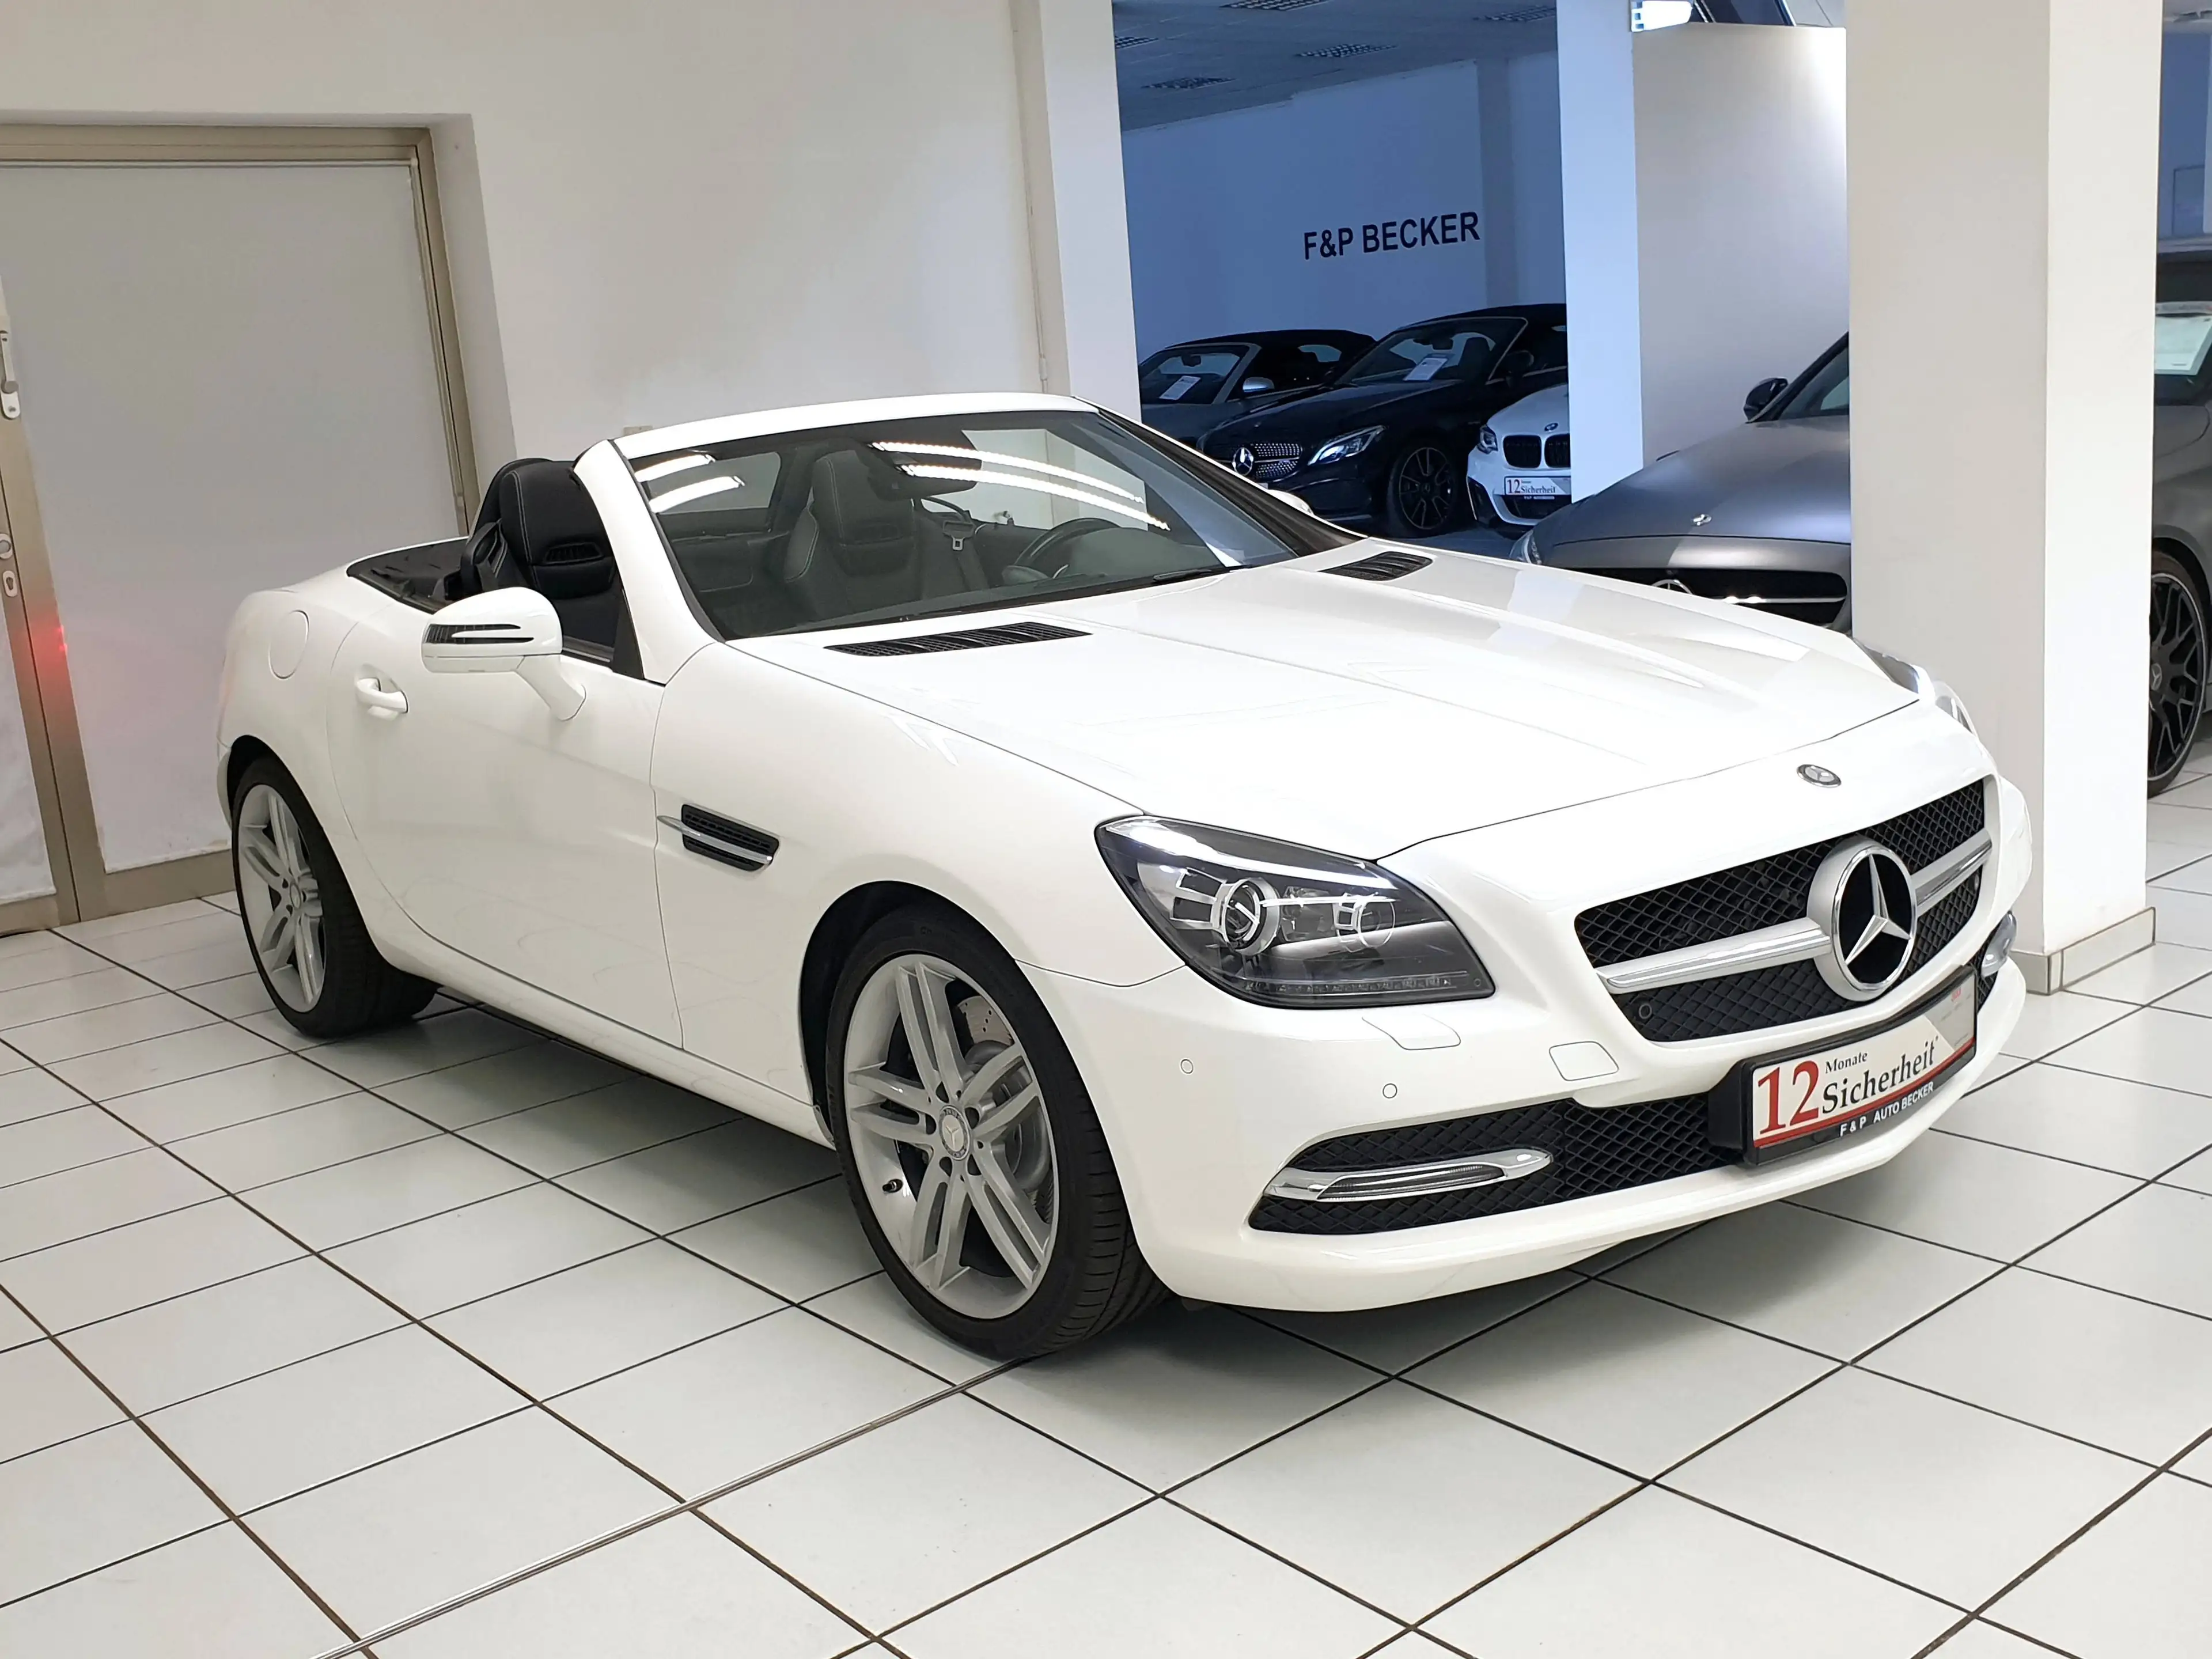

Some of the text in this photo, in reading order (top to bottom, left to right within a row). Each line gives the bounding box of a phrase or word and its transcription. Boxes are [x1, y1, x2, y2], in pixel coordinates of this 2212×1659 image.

[1304, 211, 1481, 260] F&P BECKER
[1507, 479, 1521, 494] 12
[1758, 1051, 1868, 1134] 12 Monate
[1873, 1101, 1900, 1124] AUTO
[1901, 1081, 1934, 1111] BECKER
